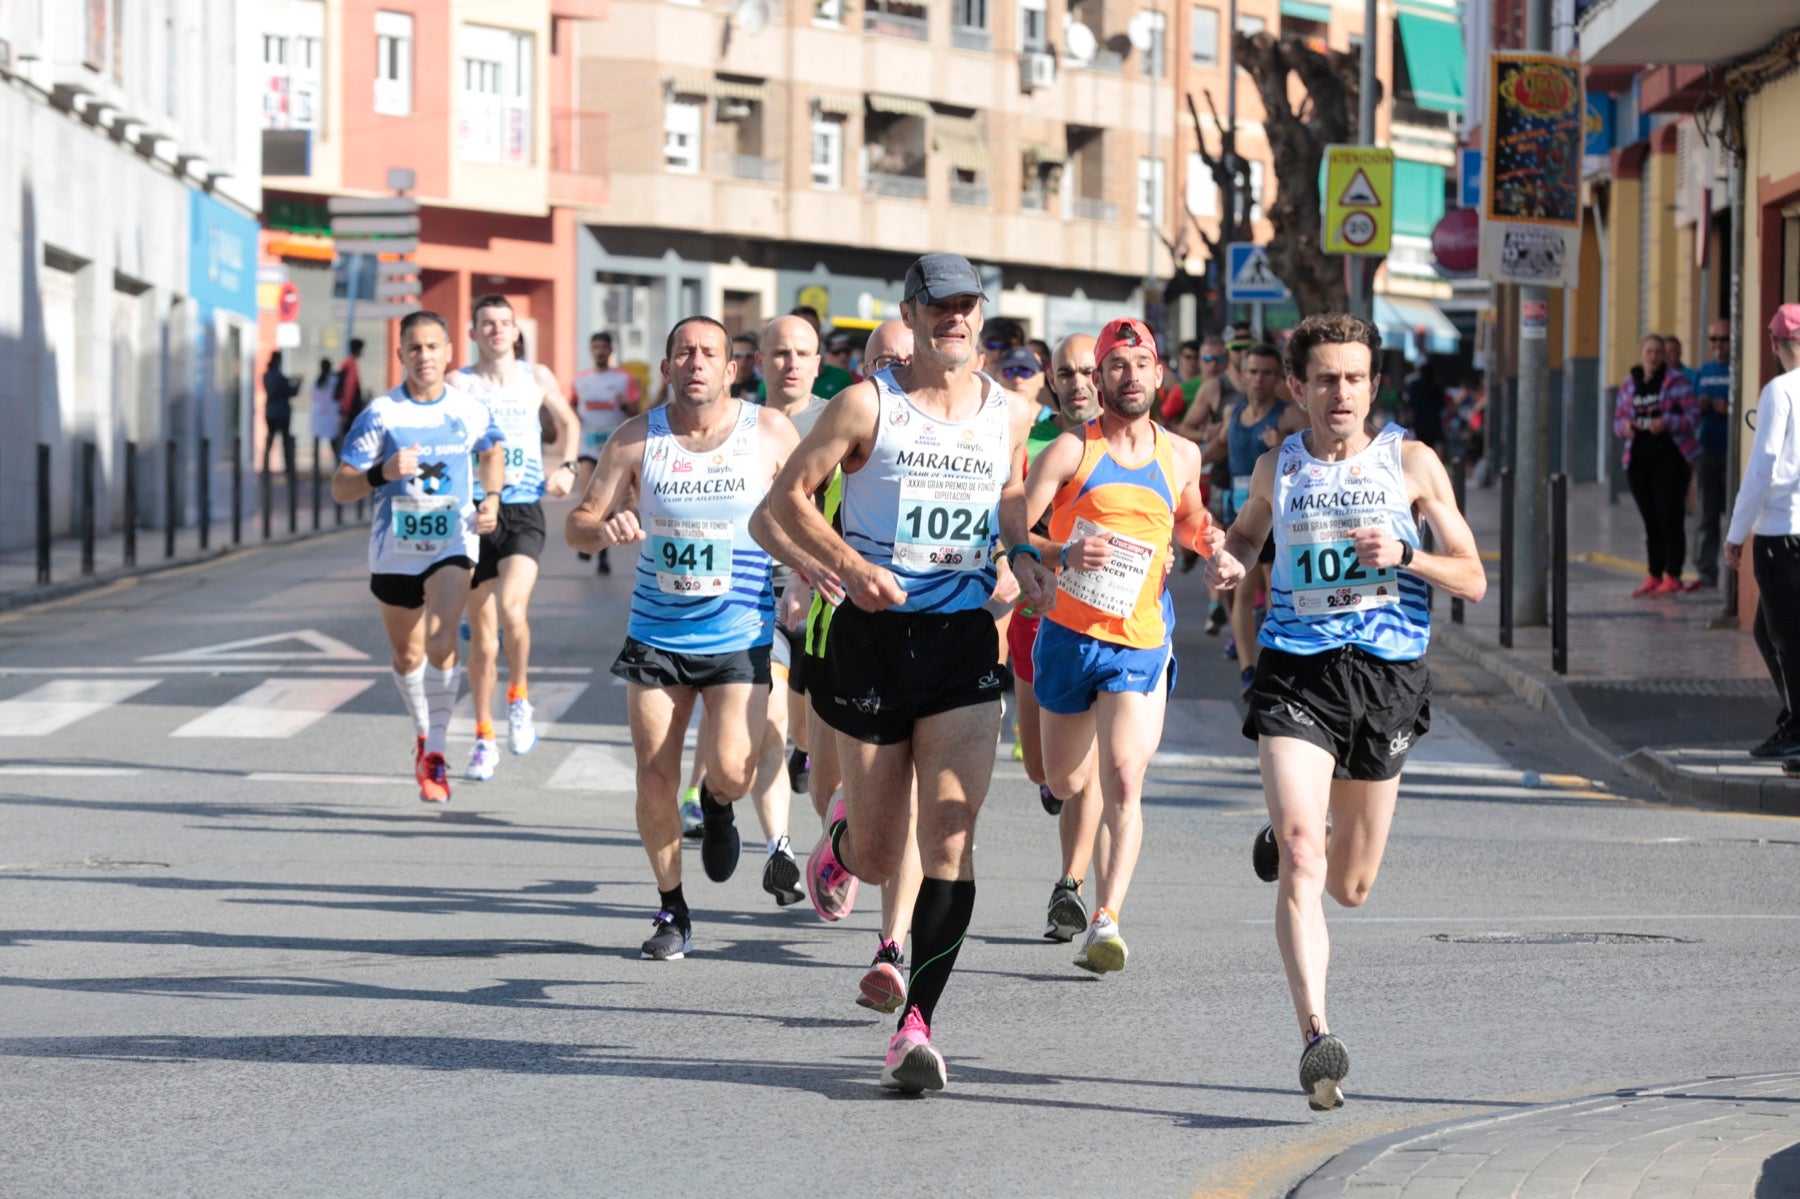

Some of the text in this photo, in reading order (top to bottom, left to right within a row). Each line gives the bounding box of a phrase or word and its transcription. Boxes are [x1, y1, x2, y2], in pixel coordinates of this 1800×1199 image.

[896, 450, 993, 479] MARACENA
[654, 478, 745, 496] MARACENA
[927, 480, 944, 489] GRAN
[944, 481, 968, 491] PREMIO
[970, 482, 977, 491] DE
[1290, 490, 1386, 512] MARACENA
[404, 514, 448, 537] 958
[681, 520, 700, 530] PREMIO
[709, 521, 728, 530] FONDO
[906, 505, 990, 541] 1024
[1310, 520, 1328, 531] GRAN
[1329, 519, 1351, 530] PREMIO
[1111, 536, 1146, 555] Cruzcampo
[662, 541, 714, 571] 941
[1297, 546, 1387, 585] 102
[1102, 564, 1126, 578] NCER
[1110, 558, 1145, 576] CONTRA
